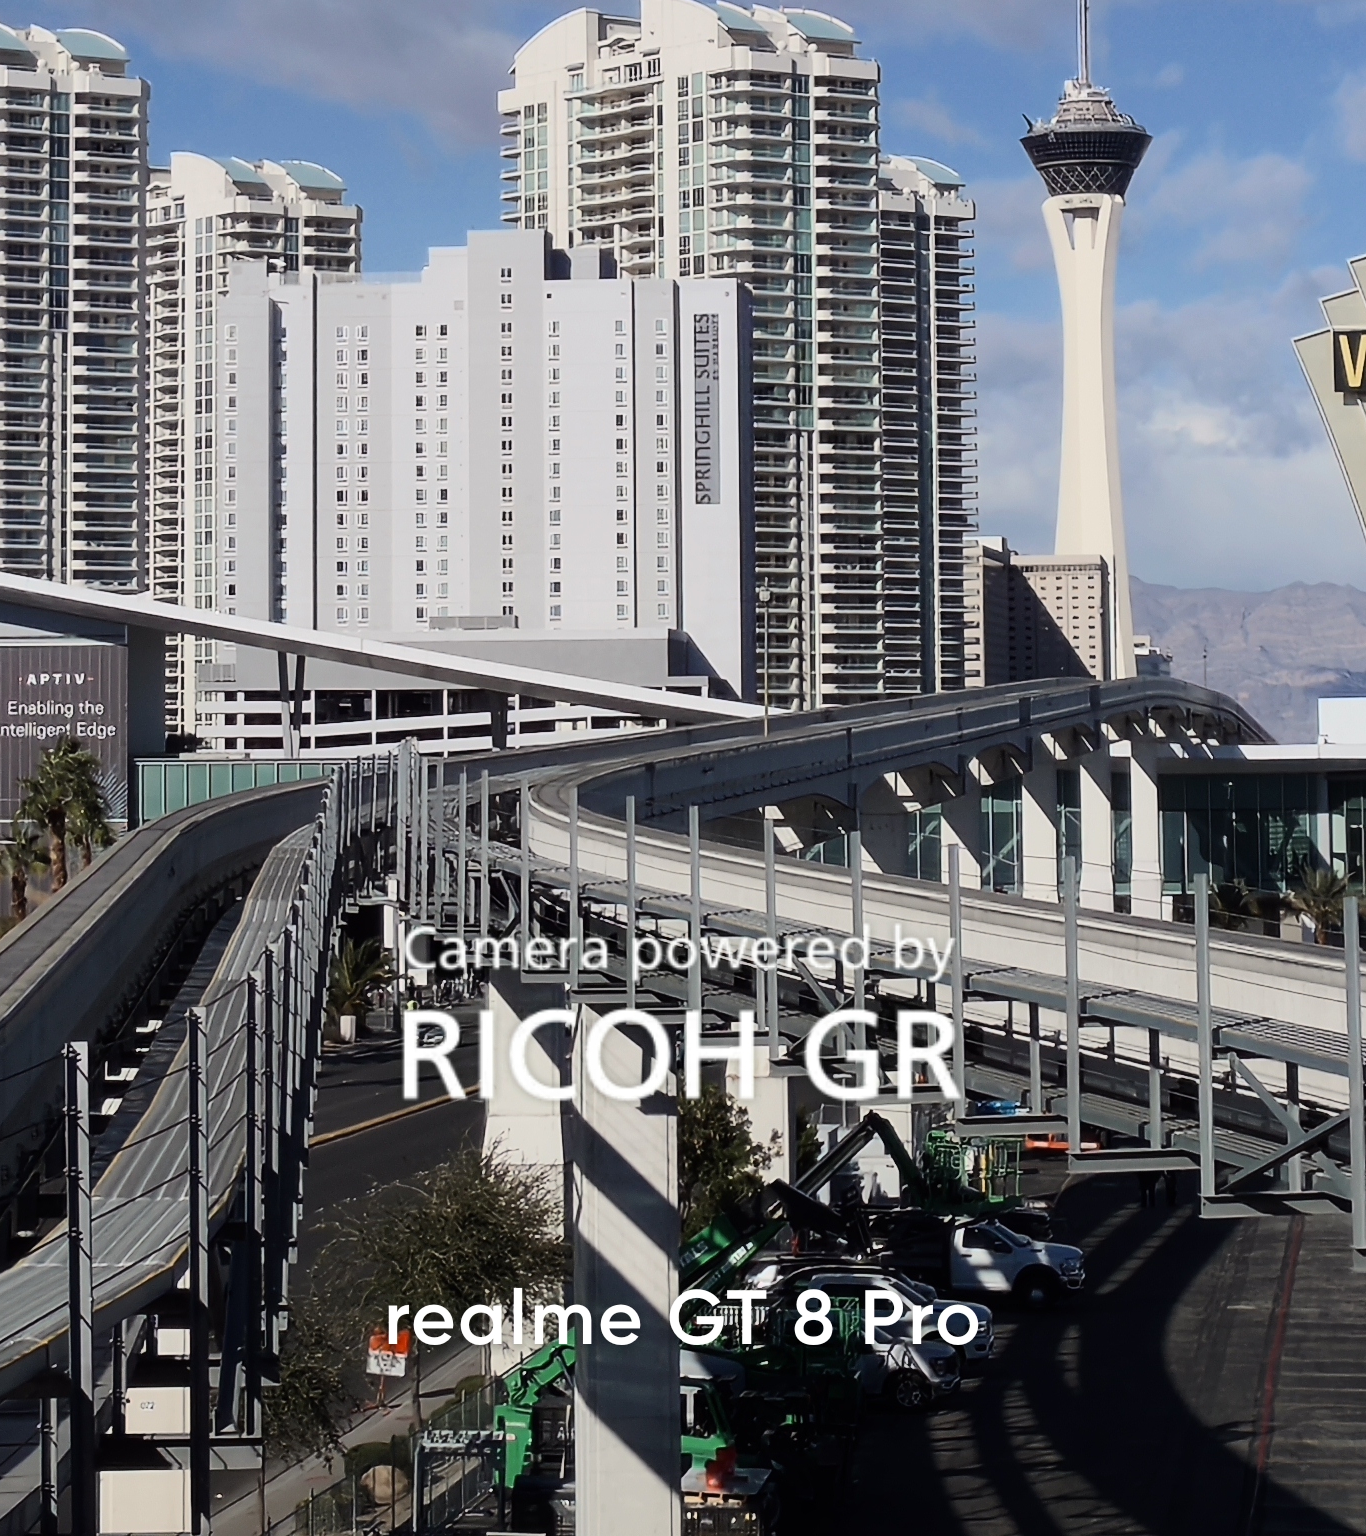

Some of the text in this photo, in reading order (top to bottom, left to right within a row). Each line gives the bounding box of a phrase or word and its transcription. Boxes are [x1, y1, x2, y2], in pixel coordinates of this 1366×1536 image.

[694, 314, 711, 504] SPRINGHILL SUITES
[26, 673, 85, 685] APTIV
[7, 700, 105, 718] Enabling the
[76, 721, 117, 739] Edge
